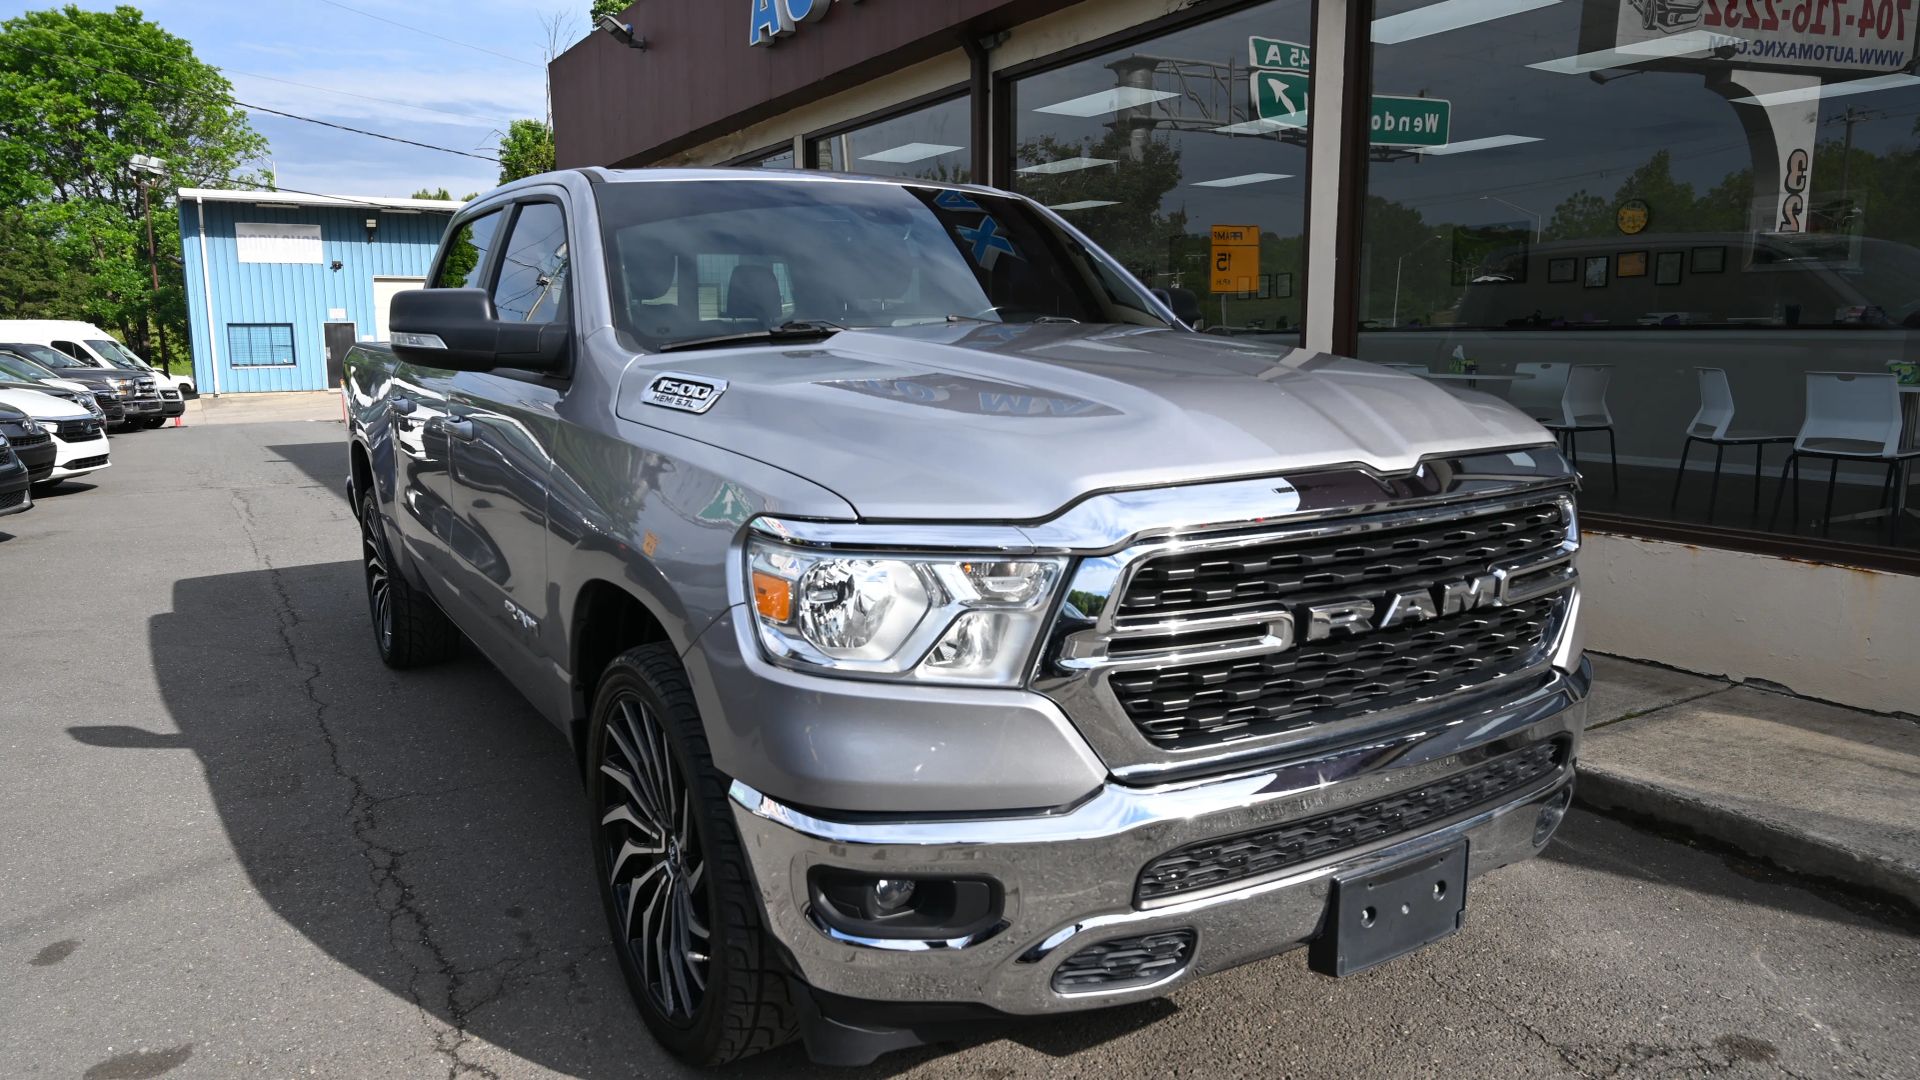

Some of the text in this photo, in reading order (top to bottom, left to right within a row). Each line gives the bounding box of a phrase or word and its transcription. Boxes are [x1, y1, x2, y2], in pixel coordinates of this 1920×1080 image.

[653, 393, 674, 404] HEMI
[657, 379, 712, 400] 1500
[1306, 574, 1501, 642] RAM
